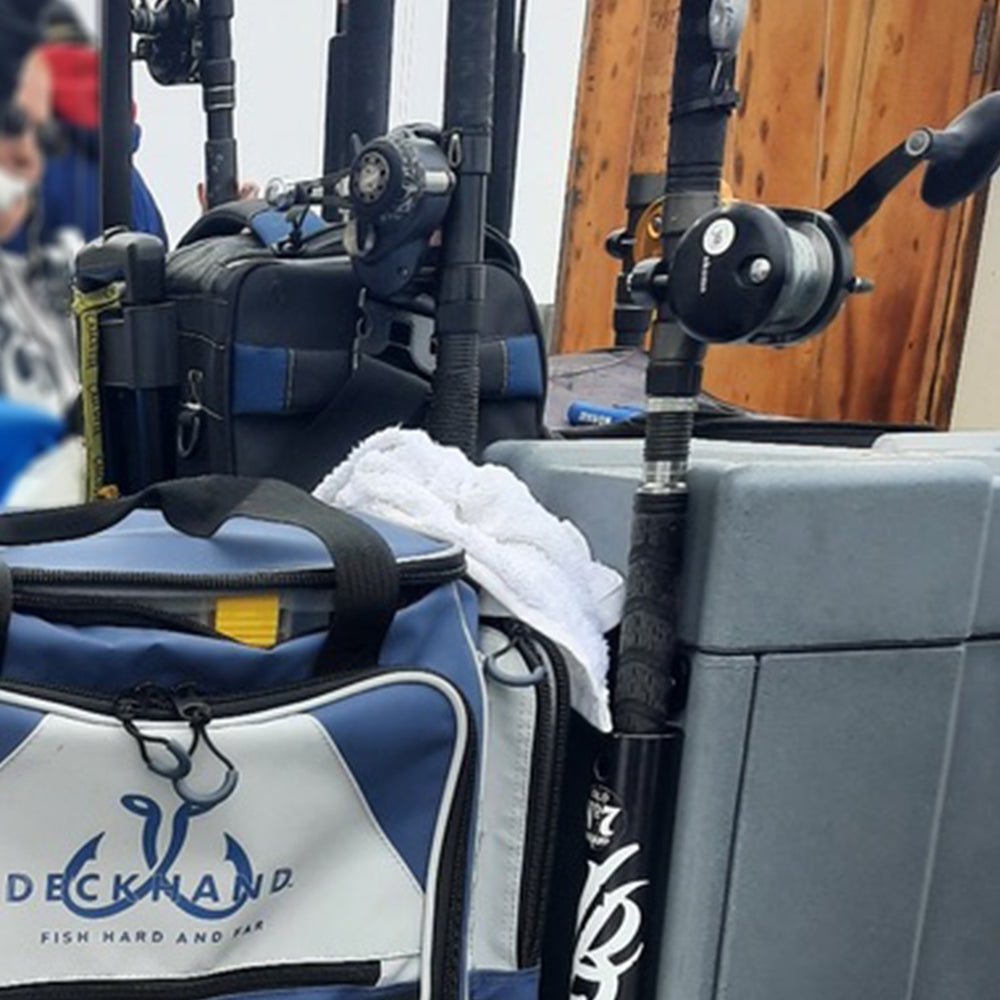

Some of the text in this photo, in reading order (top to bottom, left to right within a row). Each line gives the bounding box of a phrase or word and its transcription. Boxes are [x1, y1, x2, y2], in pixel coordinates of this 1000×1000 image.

[40, 930, 89, 944] FISH
[102, 930, 164, 944] HARD
[175, 930, 222, 944] AND
